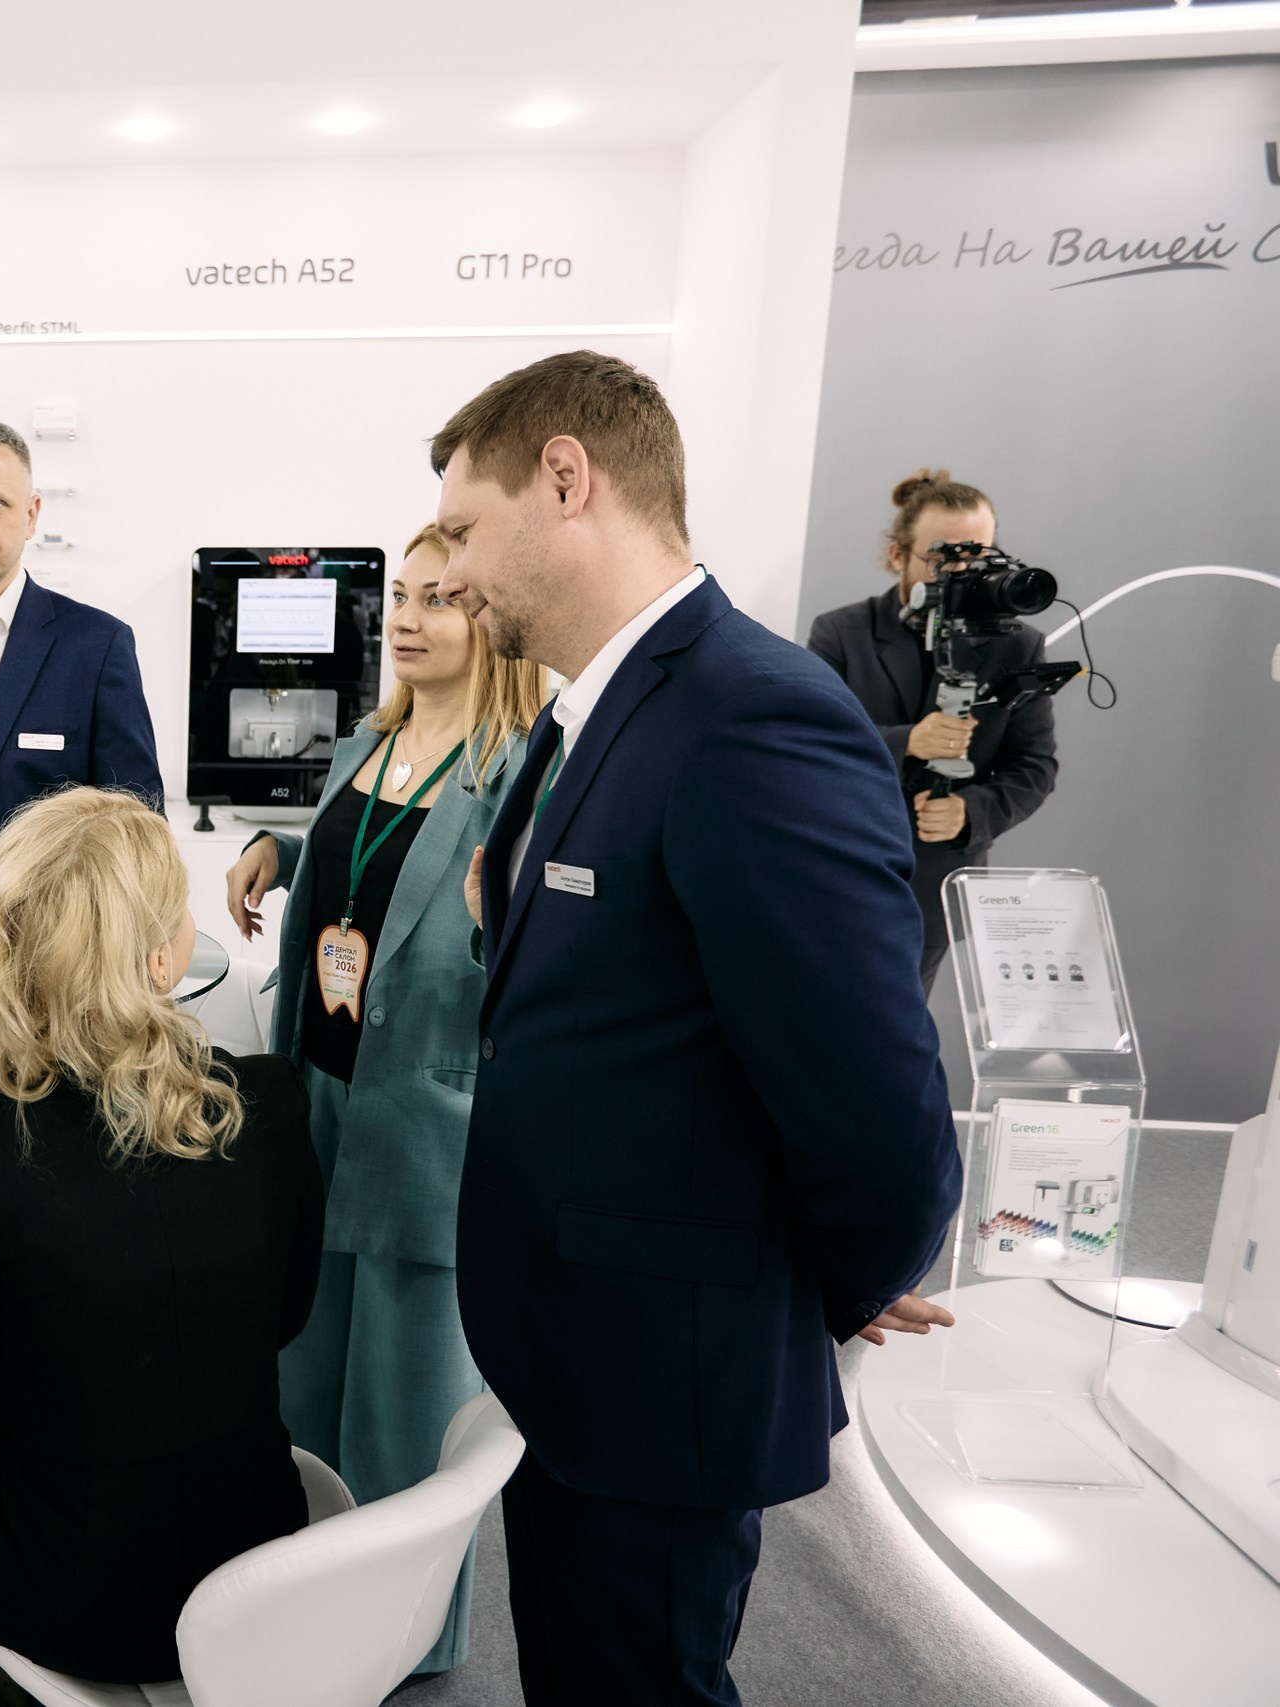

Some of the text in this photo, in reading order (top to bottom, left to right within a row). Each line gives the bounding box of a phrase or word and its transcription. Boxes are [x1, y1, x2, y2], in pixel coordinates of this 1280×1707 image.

[953, 228, 1031, 269] На
[1048, 222, 1239, 268] Вашей
[185, 258, 355, 286] vatech A52
[457, 253, 572, 280] GT1 Pro
[40, 321, 82, 334] STML
[268, 553, 309, 566] vatech
[271, 788, 290, 797] A52
[978, 895, 1022, 905] Green 16
[335, 960, 357, 973] 2026
[1010, 1122, 1060, 1135] Green 16
